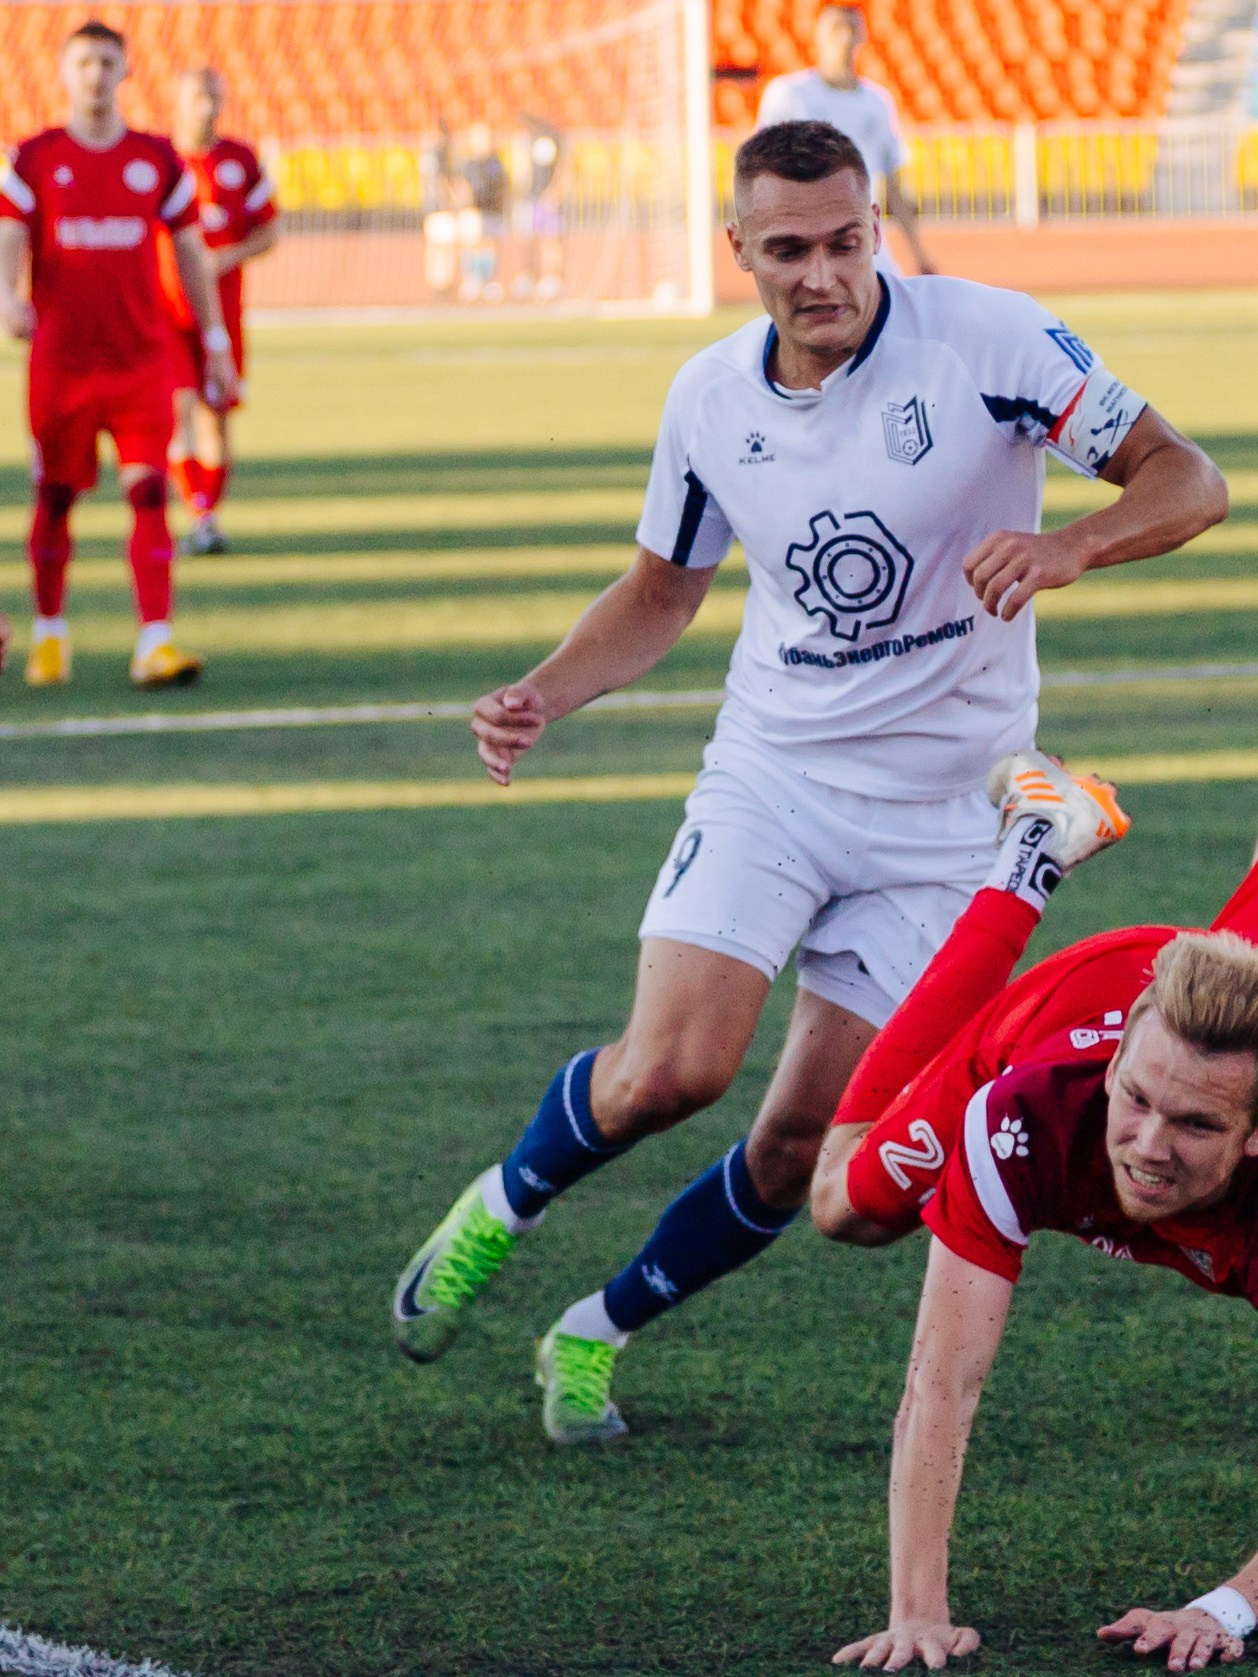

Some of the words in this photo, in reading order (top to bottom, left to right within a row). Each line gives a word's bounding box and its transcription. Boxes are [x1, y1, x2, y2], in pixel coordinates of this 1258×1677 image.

[738, 454, 776, 465] KELME
[663, 829, 703, 899] 9
[878, 1118, 945, 1206] 2
